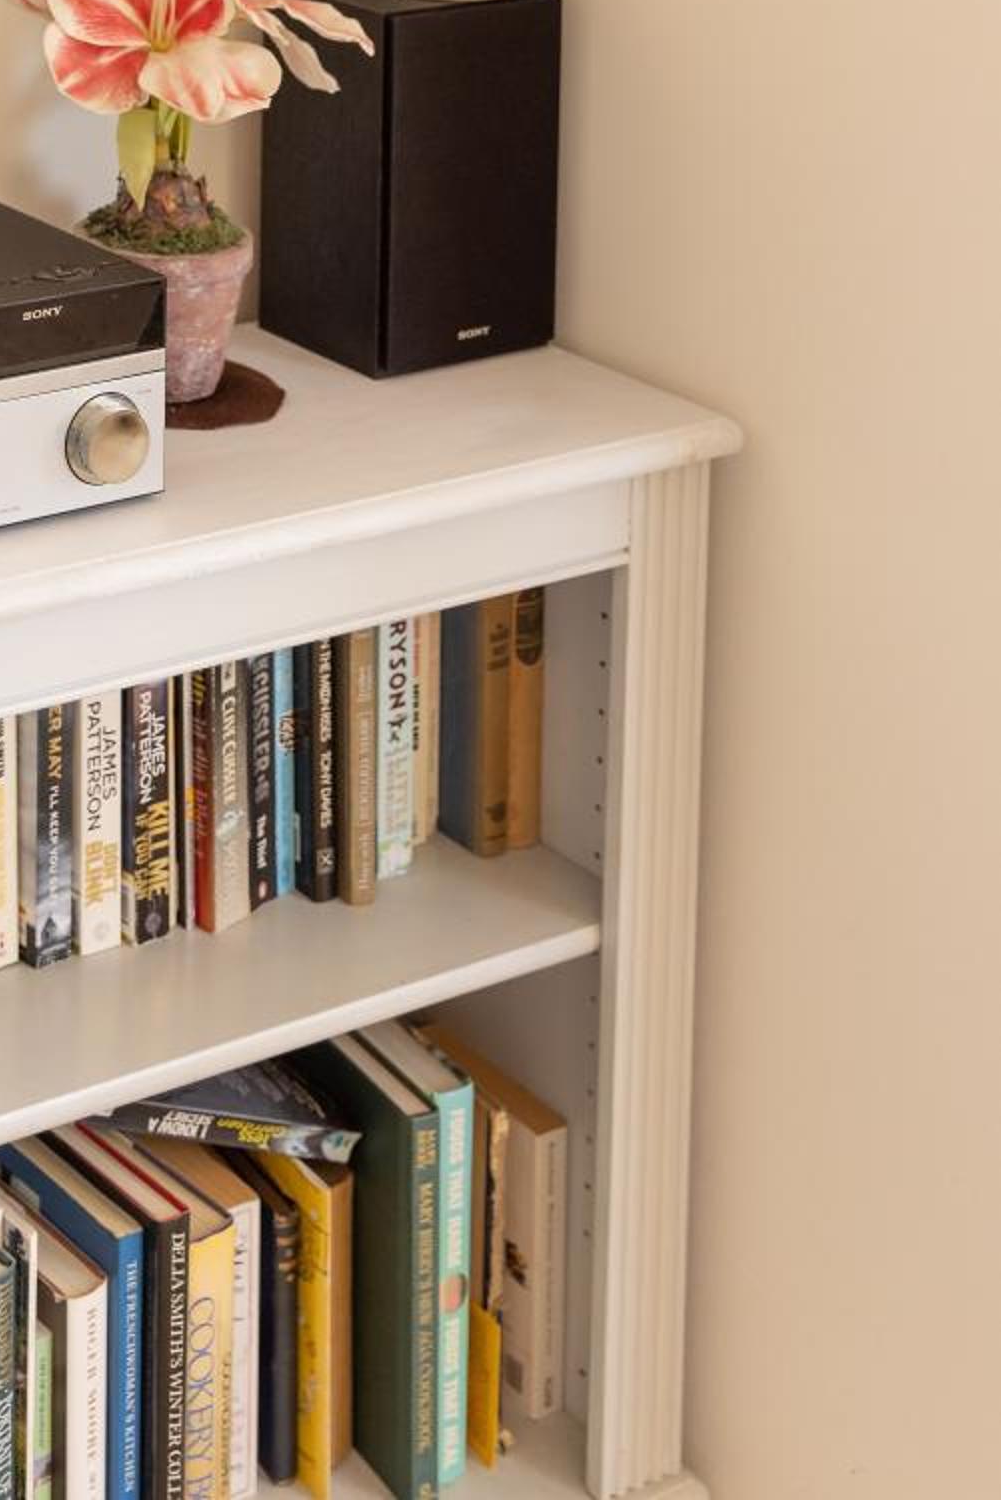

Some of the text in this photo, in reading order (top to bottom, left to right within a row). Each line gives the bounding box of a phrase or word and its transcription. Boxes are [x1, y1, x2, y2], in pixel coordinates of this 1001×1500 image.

[22, 304, 64, 321] SONY
[457, 325, 491, 341] SONY
[388, 620, 408, 710] RYSON
[48, 736, 63, 780] MAY
[138, 691, 152, 805] PATTERSON
[150, 712, 166, 777] JAMES
[252, 672, 270, 772] CUSSLER
[86, 700, 102, 832] PATTERSON
[102, 726, 118, 801] JAMES
[149, 855, 170, 897] ME
[147, 1115, 160, 1134] A
[126, 1260, 139, 1289] THE
[87, 1306, 99, 1382] ROGER
[167, 1232, 187, 1500] DELIA SMITH'S WINTER COLL
[187, 1296, 216, 1461] COOKERY
[122, 1423, 137, 1494] KITCHEN
